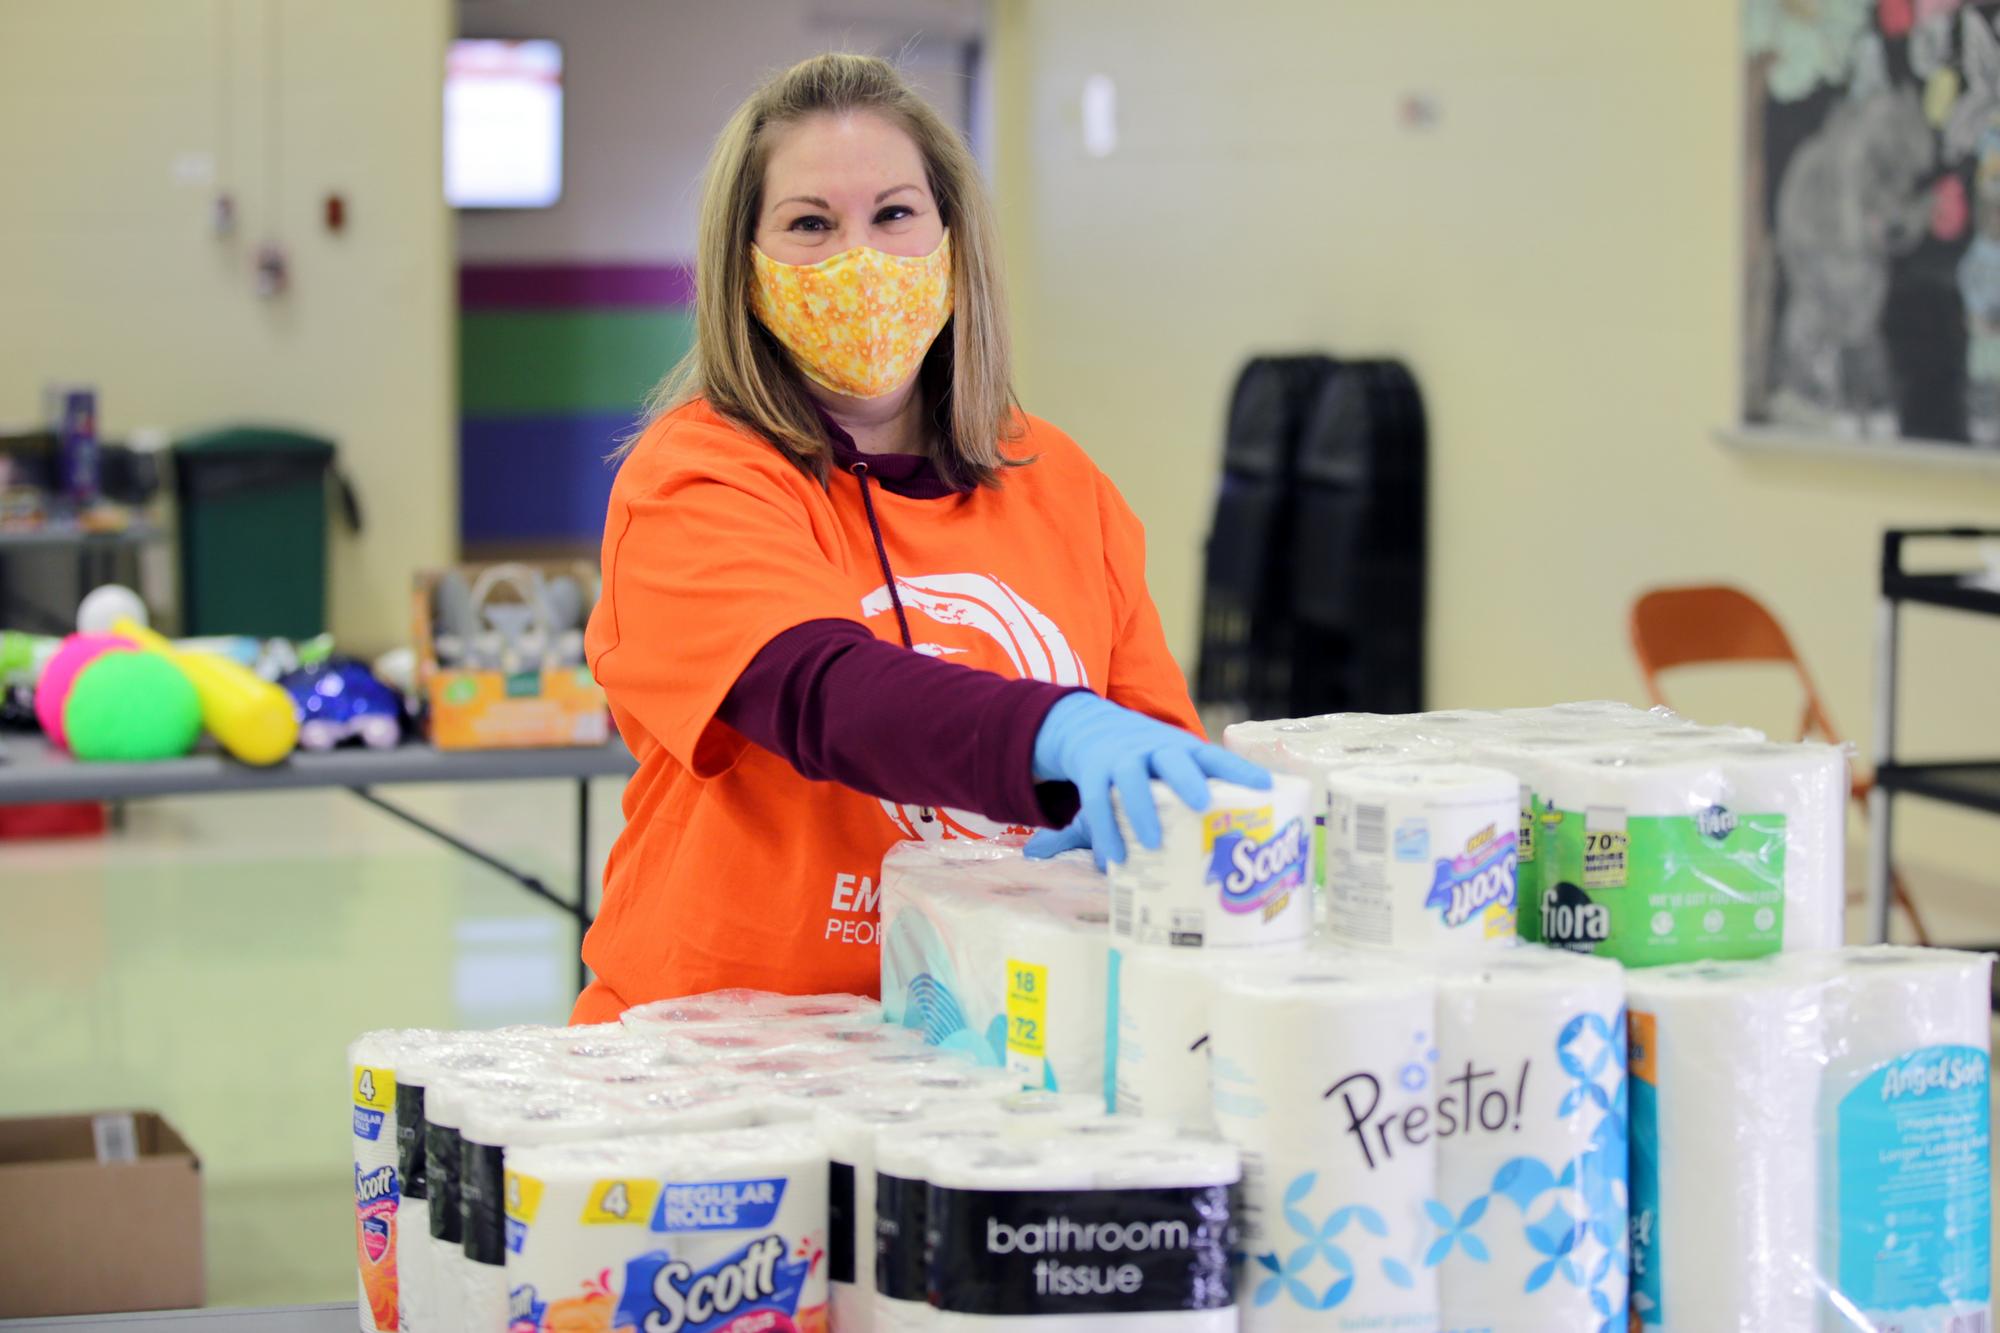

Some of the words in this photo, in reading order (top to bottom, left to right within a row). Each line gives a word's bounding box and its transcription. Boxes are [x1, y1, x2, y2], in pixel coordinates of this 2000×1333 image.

[1225, 817, 1303, 895] Scott
[1446, 853, 1516, 928] Scott
[1540, 888, 1610, 939] fiora
[1014, 970, 1035, 992] 18
[1015, 1017, 1037, 1040] 72
[359, 1070, 375, 1101] 4
[1882, 1056, 1950, 1102] Angel
[1950, 1056, 1985, 1090] Soft
[1323, 1059, 1531, 1169] Presto!
[356, 1164, 394, 1201] Scott
[601, 1182, 630, 1218] 4
[666, 1183, 776, 1205] REGULAR
[665, 1204, 738, 1229] ROLLS
[987, 1217, 1190, 1254] bathroom
[643, 1234, 786, 1333] Scott
[1033, 1260, 1144, 1295] tissue
